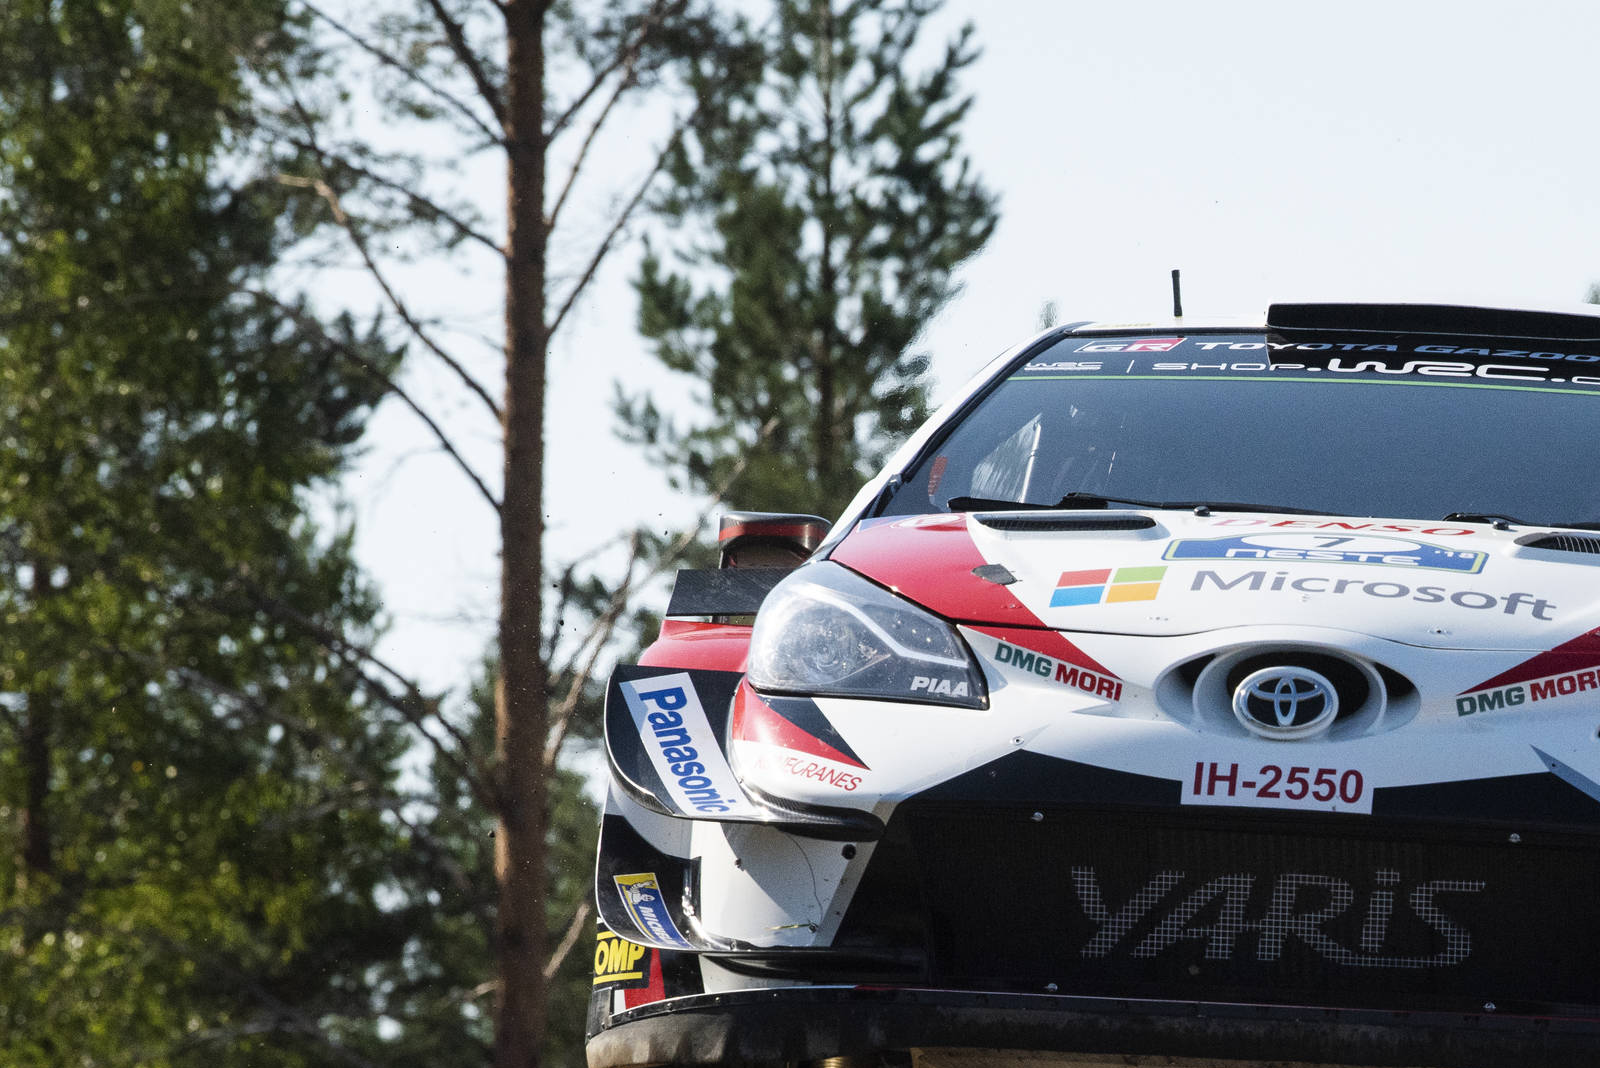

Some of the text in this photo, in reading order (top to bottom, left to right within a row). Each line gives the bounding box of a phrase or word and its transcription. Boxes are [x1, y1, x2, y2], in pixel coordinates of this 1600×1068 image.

[1195, 341, 1399, 352] TOYOTA
[1414, 345, 1600, 362] GAZOO
[1211, 519, 1475, 536] DENSO
[1313, 536, 1355, 548] 7
[1225, 548, 1421, 567] NESTE
[1190, 570, 1556, 621] Microsoft
[910, 676, 970, 697] PIAA
[994, 642, 1122, 702] DMG MORI
[1456, 686, 1525, 717] DMG
[639, 686, 737, 813] Panasonic
[1193, 762, 1363, 804] IH-2550
[594, 938, 646, 975] OMP
